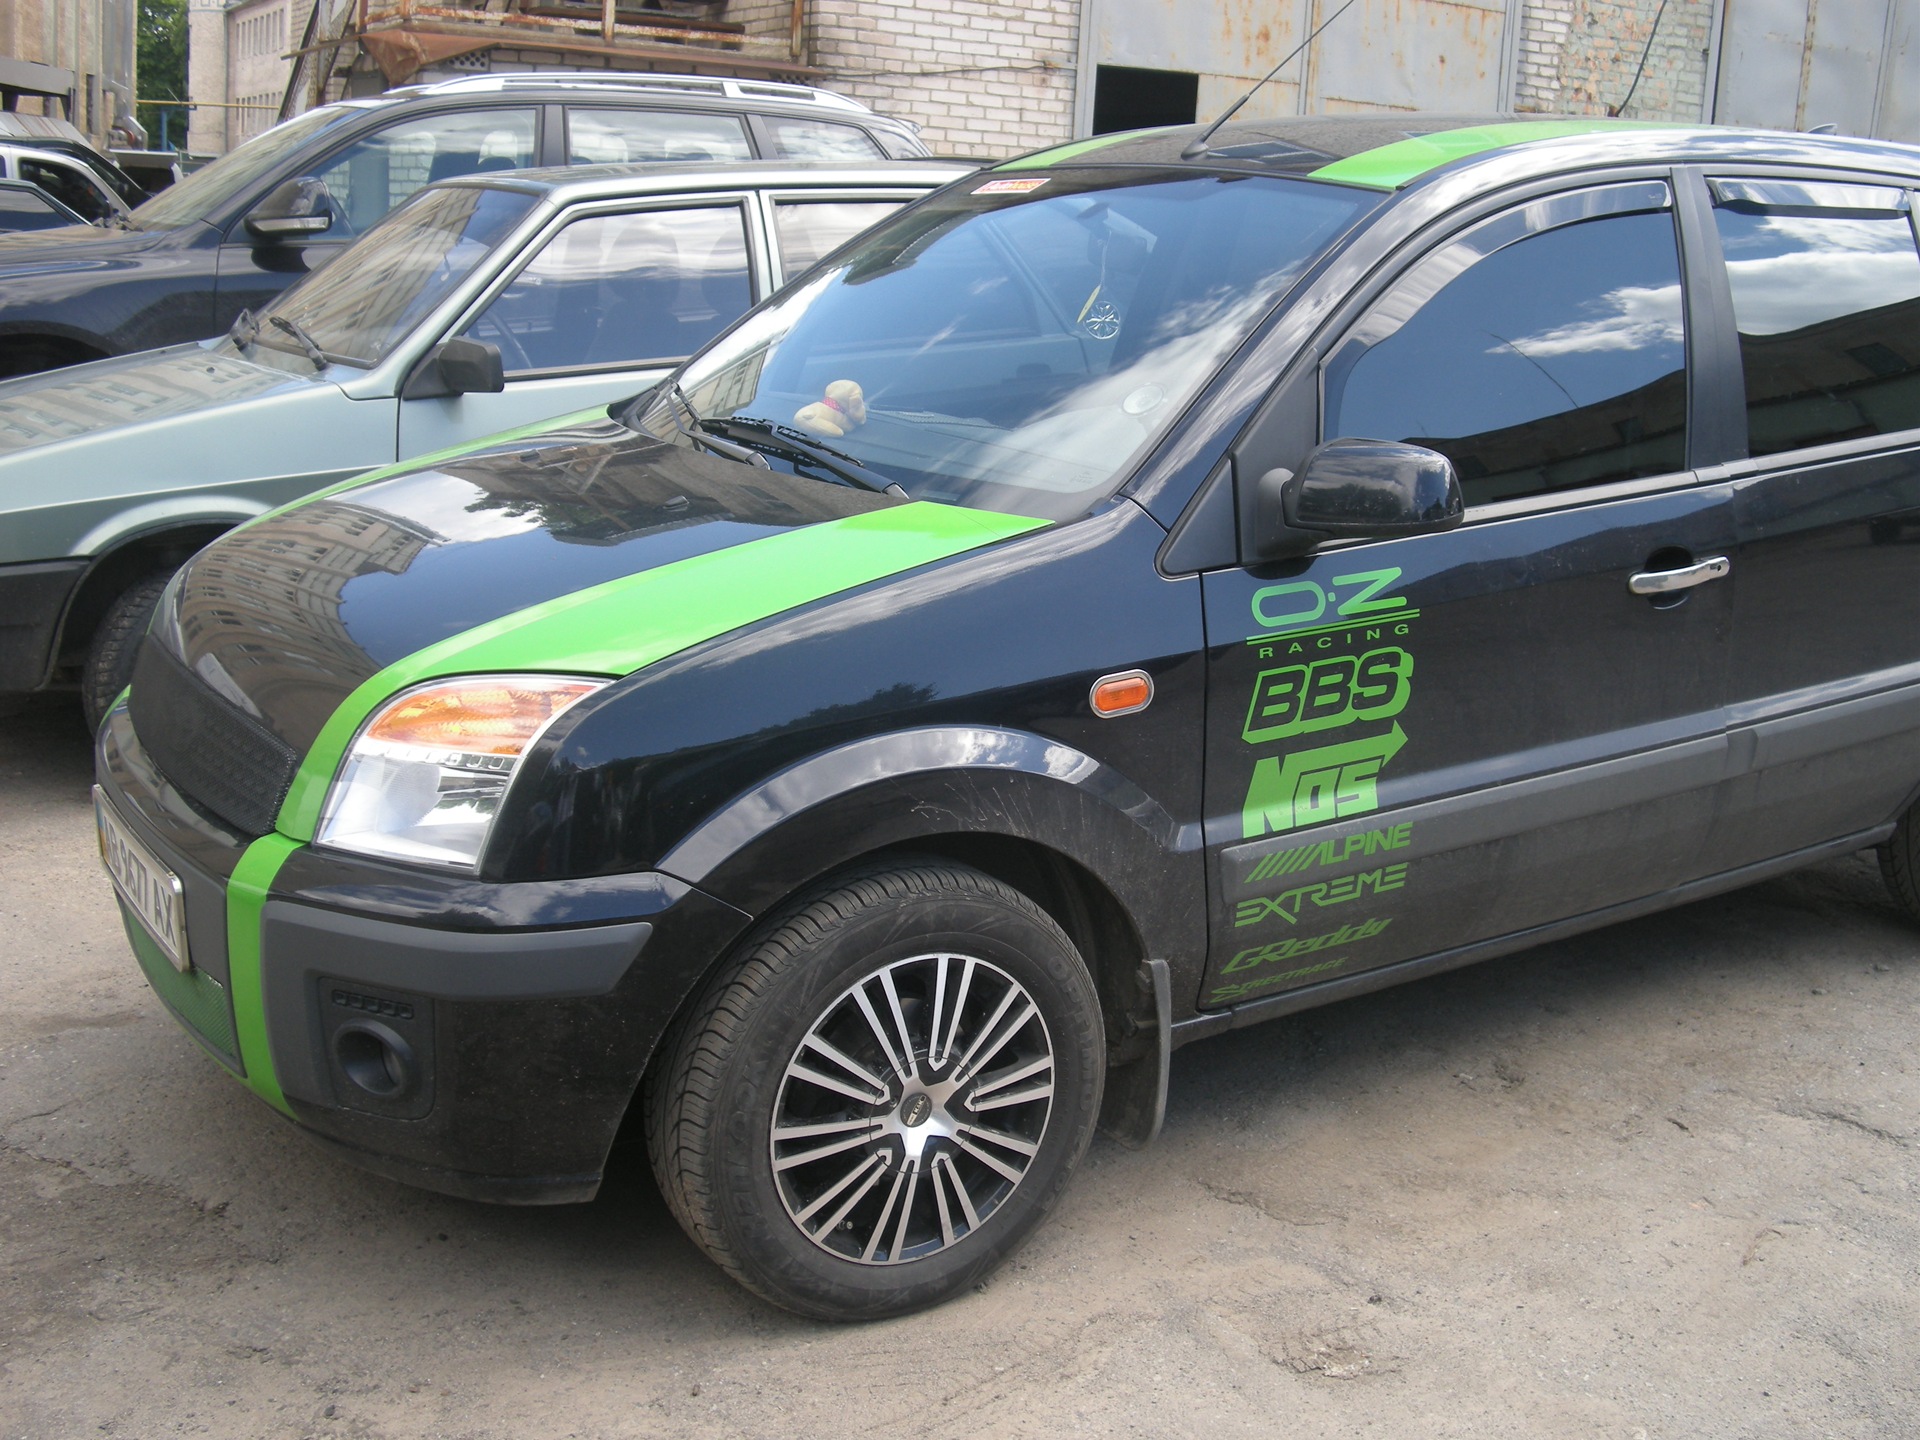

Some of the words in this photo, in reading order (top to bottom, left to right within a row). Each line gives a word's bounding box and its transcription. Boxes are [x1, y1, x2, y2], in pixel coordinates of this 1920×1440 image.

[1259, 623, 1409, 659] RACING
[1241, 645, 1414, 745] BBS
[1242, 719, 1409, 839] NOS
[153, 878, 177, 947] AX
[1234, 861, 1409, 928] EXTREME
